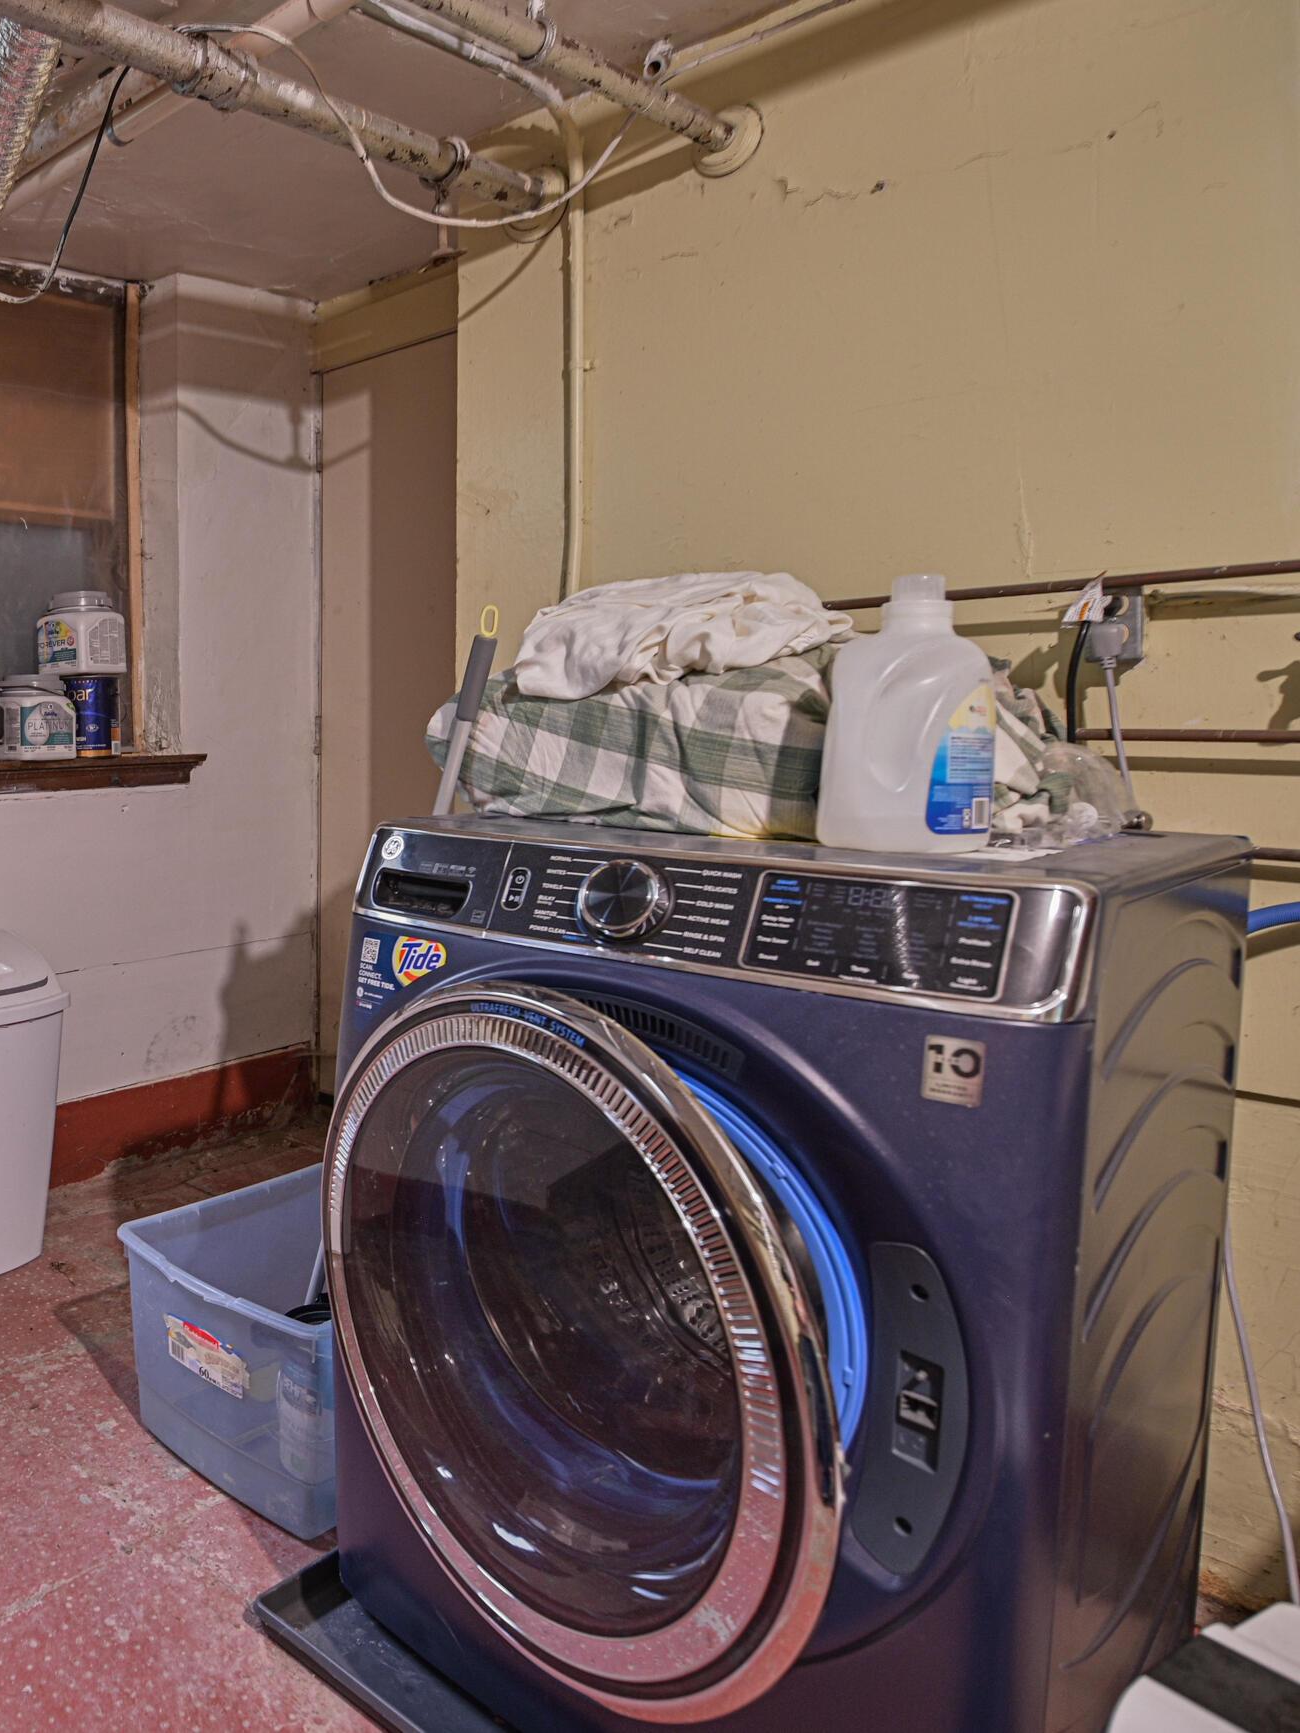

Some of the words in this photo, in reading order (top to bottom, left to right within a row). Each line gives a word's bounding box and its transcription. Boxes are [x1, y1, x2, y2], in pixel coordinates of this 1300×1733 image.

[702, 869, 722, 877] QUICK
[703, 884, 739, 895] DELICATES
[687, 915, 710, 924] ACTIVE
[528, 924, 548, 932] POWER
[548, 926, 566, 934] CLEAN
[683, 931, 703, 939] RINSE
[699, 948, 722, 958] CLEAN
[398, 942, 442, 975] Tide
[357, 976, 368, 984] GET
[470, 1002, 522, 1018] ULTRAFRESH
[524, 1010, 549, 1026] VENT
[549, 1020, 587, 1048] SYSTEM
